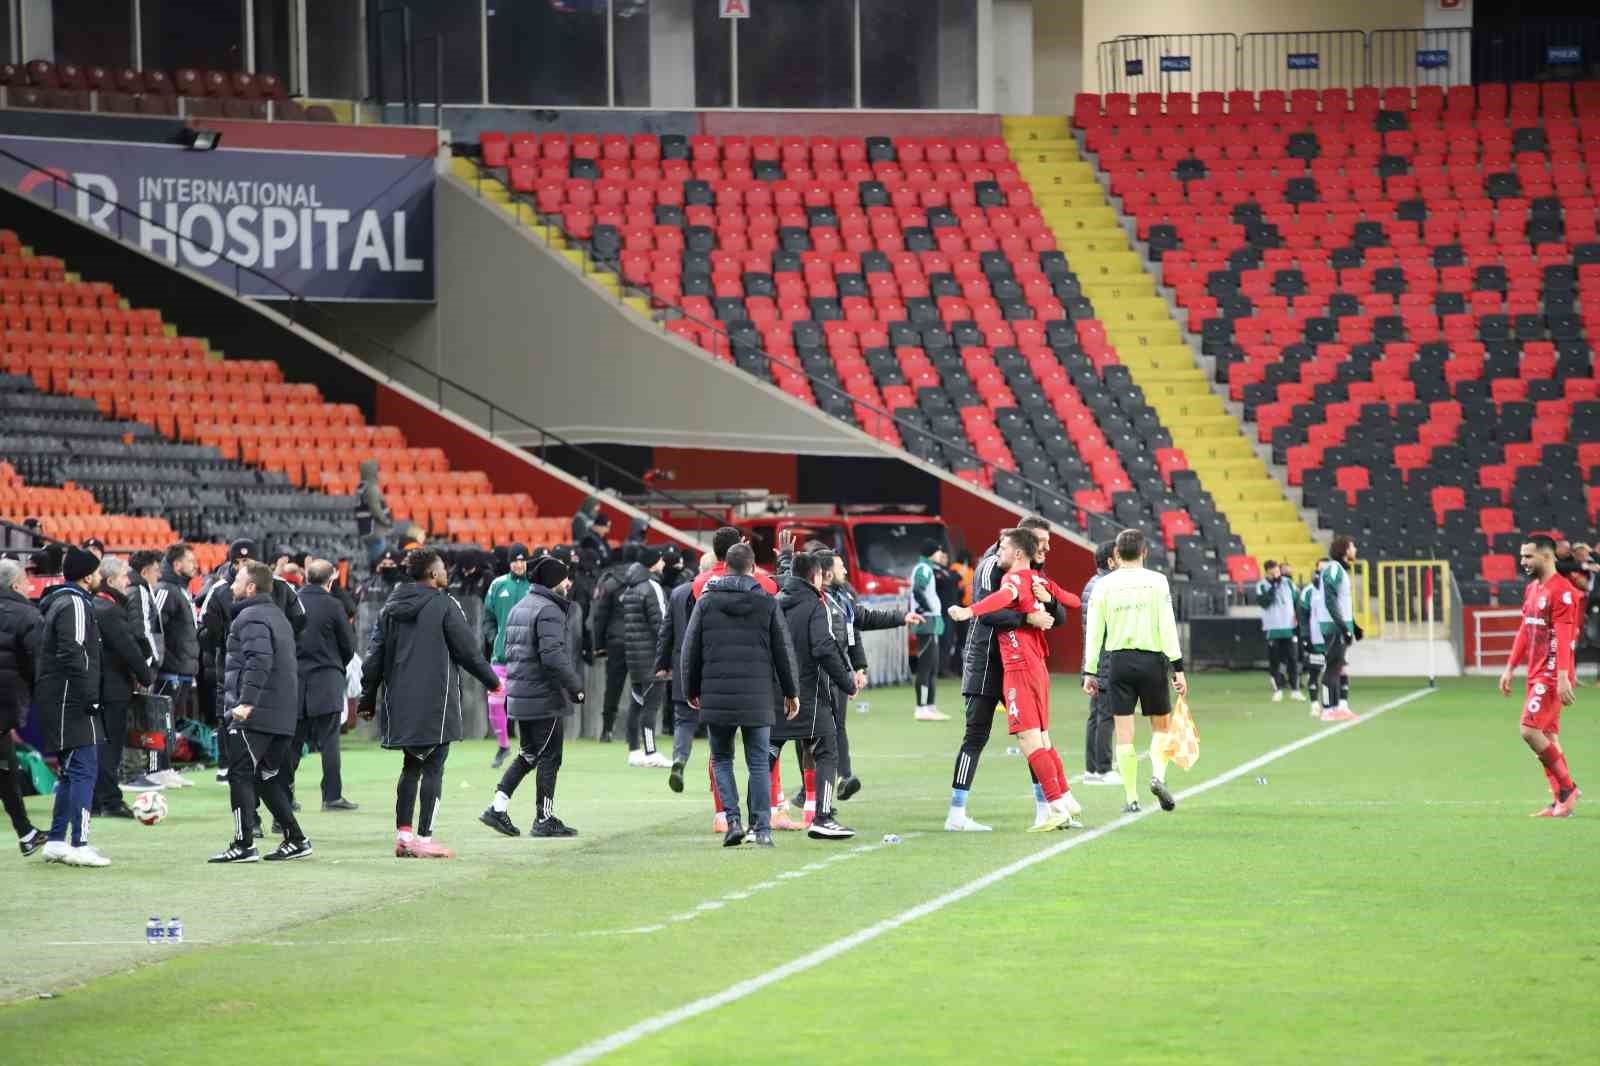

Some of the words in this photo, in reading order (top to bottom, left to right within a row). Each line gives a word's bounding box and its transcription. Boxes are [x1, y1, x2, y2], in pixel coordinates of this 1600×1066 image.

[138, 177, 322, 208] INTERNATIONAL
[138, 201, 424, 271] HOSPITAL
[1008, 701, 1019, 717] 4
[1528, 696, 1541, 713] 6
